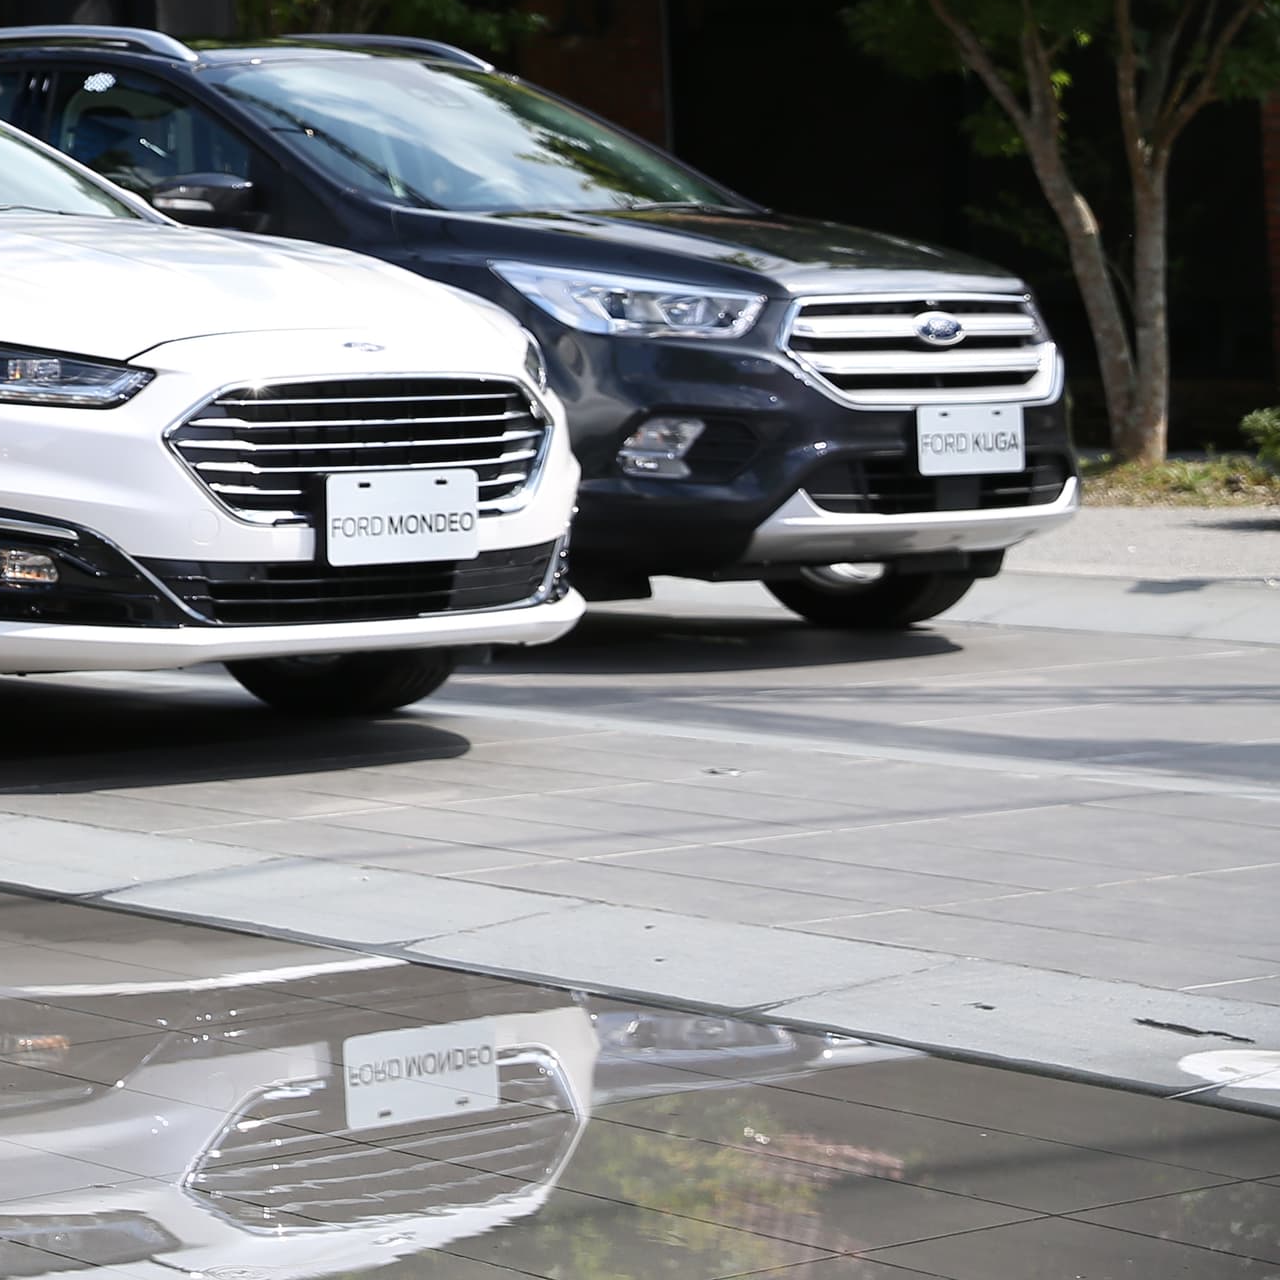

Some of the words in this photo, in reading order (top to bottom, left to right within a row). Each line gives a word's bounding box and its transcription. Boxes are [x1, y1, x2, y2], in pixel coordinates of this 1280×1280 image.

[920, 432, 968, 455] FORD
[971, 431, 1019, 454] KUGA
[331, 516, 384, 538] FORD
[387, 511, 474, 536] MONDEO
